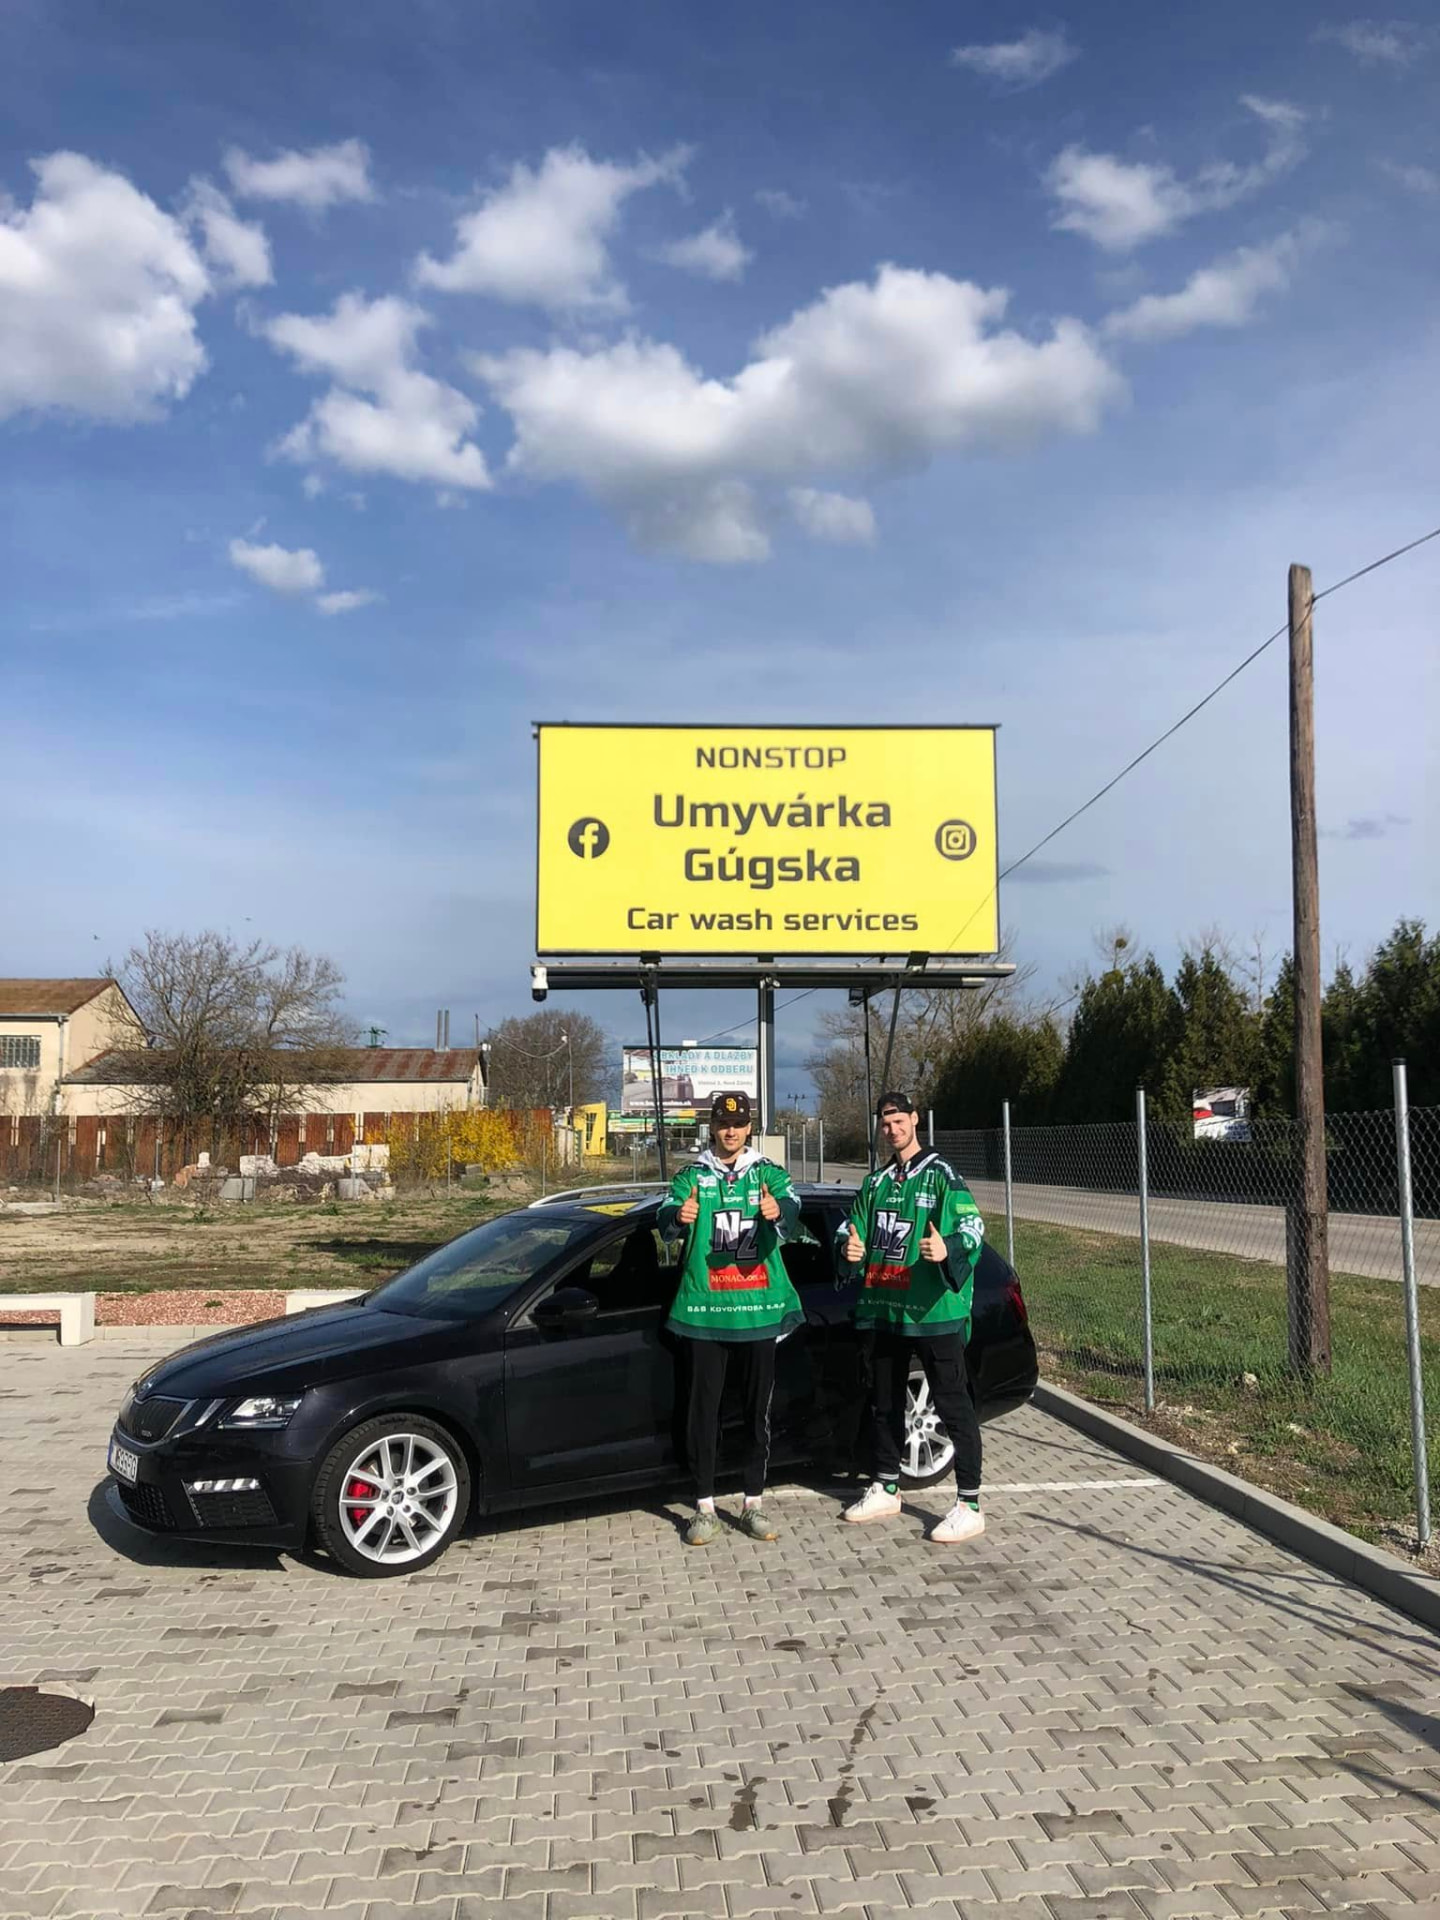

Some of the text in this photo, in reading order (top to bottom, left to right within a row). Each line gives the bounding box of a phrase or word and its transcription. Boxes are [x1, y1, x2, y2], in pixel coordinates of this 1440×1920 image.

[696, 747, 847, 769] NONSTOP
[653, 793, 891, 836] Umyvárka
[684, 846, 860, 890] Gúgska
[627, 907, 919, 931] Car wash services
[653, 1051, 702, 1060] BKLADY
[701, 1065, 708, 1074] K
[711, 1064, 753, 1074] ODBERU
[712, 1210, 759, 1260] NZ
[871, 1209, 915, 1261] NZ
